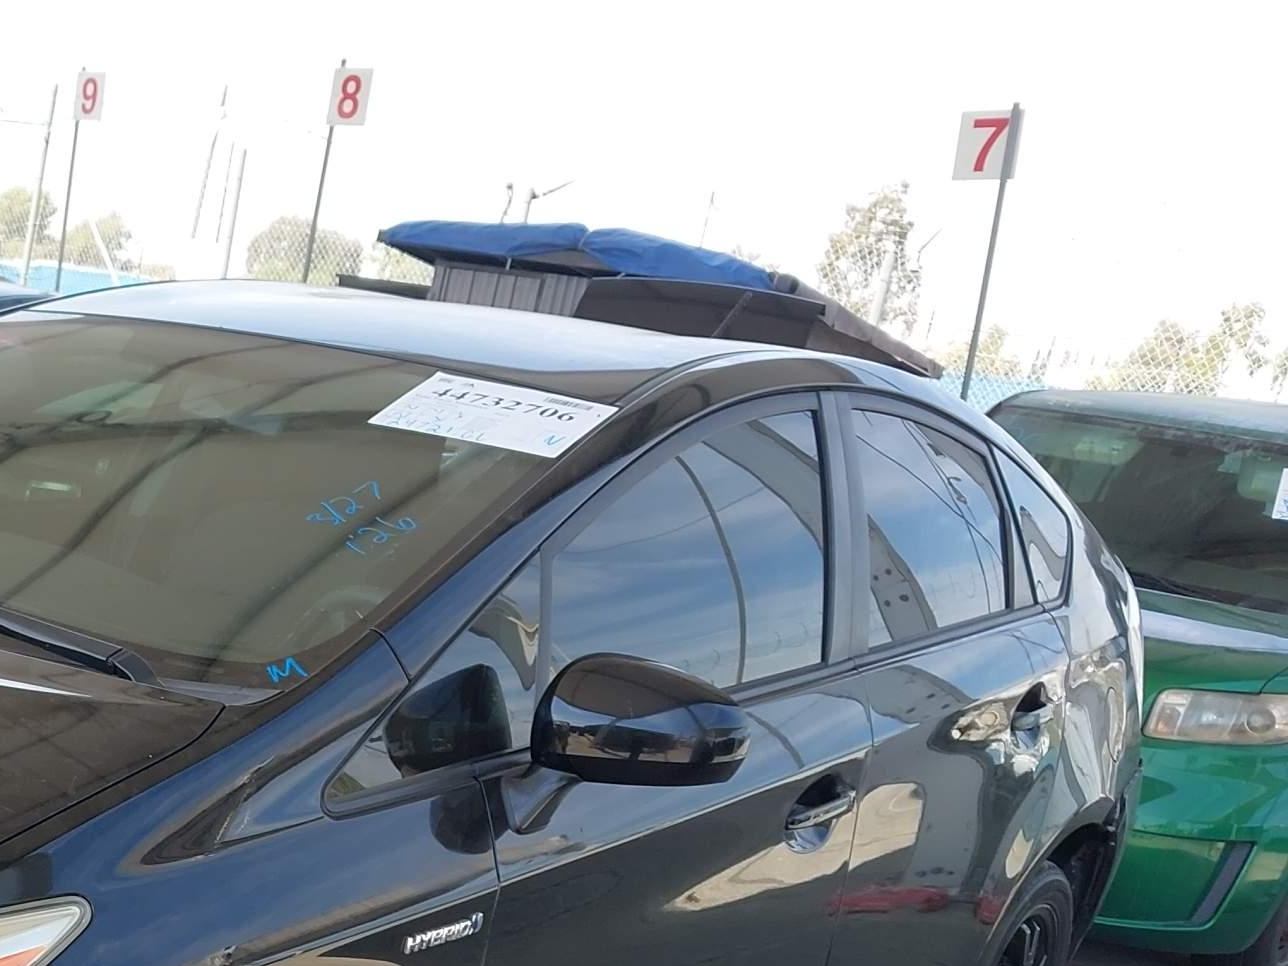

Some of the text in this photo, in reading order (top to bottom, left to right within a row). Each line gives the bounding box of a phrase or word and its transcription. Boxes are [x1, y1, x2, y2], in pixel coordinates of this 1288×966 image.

[81, 77, 98, 115] 9
[337, 74, 362, 119] 8
[973, 117, 1011, 172] 7
[431, 386, 577, 423] 44732706
[403, 919, 473, 955] HYBRID
